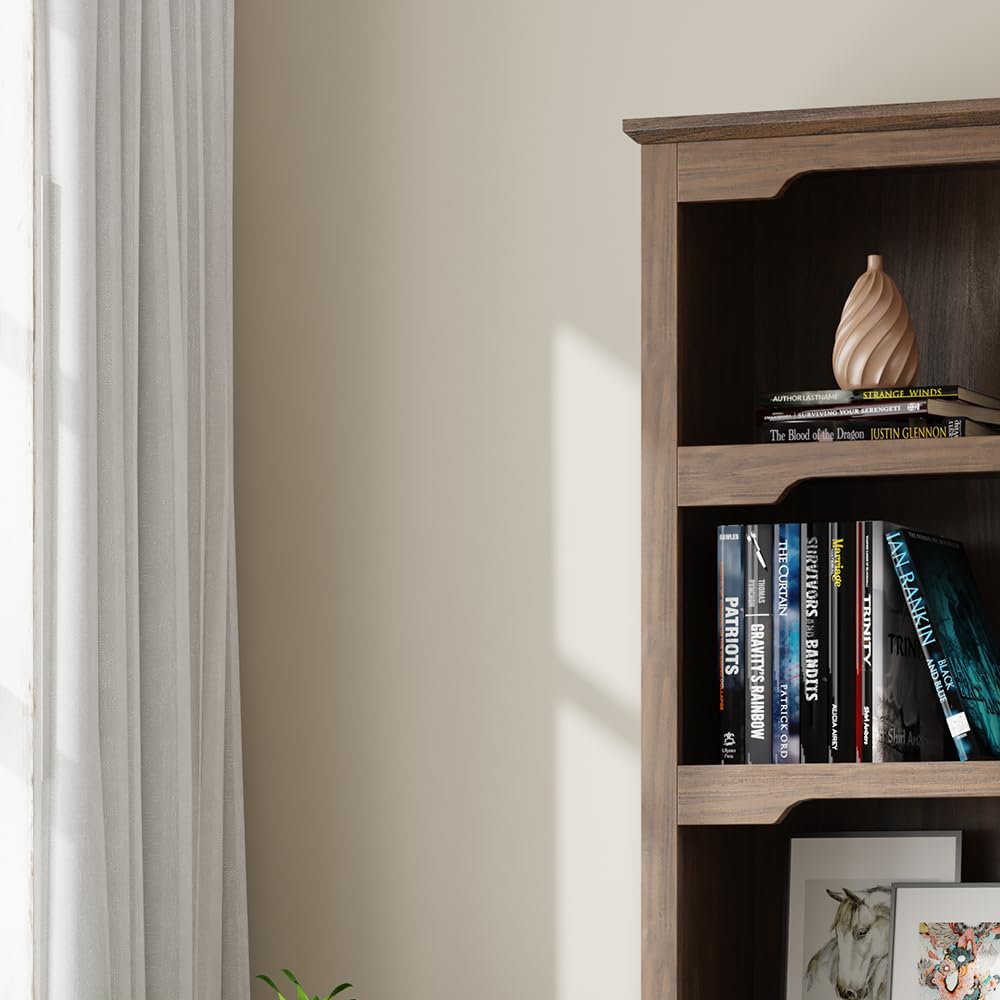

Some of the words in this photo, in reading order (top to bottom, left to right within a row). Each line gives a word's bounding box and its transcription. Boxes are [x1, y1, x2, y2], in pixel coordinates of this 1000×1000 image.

[773, 392, 801, 402] AUTHOR
[797, 409, 839, 419] SURVIVING
[840, 408, 860, 417] YOUR
[861, 405, 901, 415] SERENGETI
[863, 390, 905, 399] STRANGE
[910, 388, 942, 397] WINDS
[770, 429, 786, 441] The
[788, 428, 811, 441] Blood
[812, 428, 822, 441] of
[821, 428, 834, 440] the
[836, 427, 865, 442] Dragon
[871, 427, 900, 441] JUSTIN
[902, 426, 947, 439] GLENNON
[779, 540, 788, 563] THE
[831, 538, 844, 588] Marriage
[778, 564, 789, 616] CURTAIN
[805, 537, 818, 617] SURVIVORS
[886, 532, 910, 568] IAN
[900, 571, 937, 647] RANKIN
[725, 597, 739, 675] PATRIOTS
[806, 618, 815, 637] AND
[863, 593, 872, 667] TRINITY
[750, 623, 765, 682] GRAVITY'S
[805, 639, 818, 701] BANDITS
[937, 659, 955, 691] BLACK
[926, 658, 939, 682] AND
[934, 680, 947, 703] BLUE
[750, 685, 765, 740] RAINBOW
[780, 684, 788, 730] PATRICK
[780, 734, 788, 759] ORD
